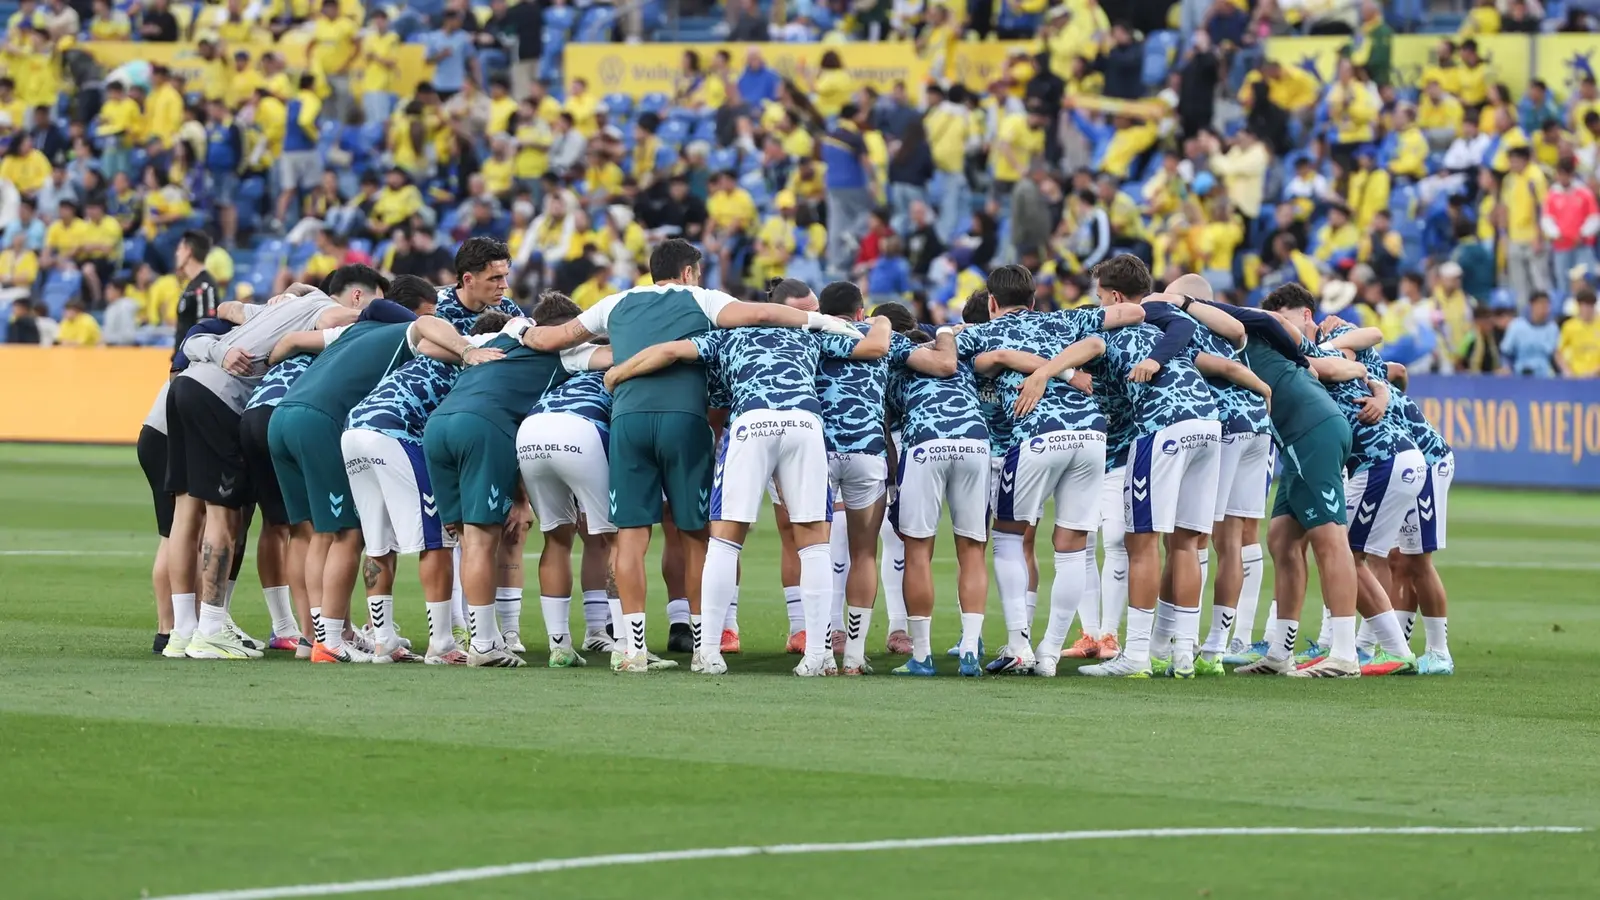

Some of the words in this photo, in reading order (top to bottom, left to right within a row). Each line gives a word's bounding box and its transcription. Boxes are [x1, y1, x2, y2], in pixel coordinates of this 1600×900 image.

[750, 421, 779, 430] COSTA
[780, 420, 798, 428] DEL
[799, 420, 814, 430] SOL
[1423, 397, 1519, 451] RISMO
[750, 427, 787, 438] MÁLAGA
[1048, 434, 1077, 444] COSTA
[1078, 433, 1095, 441] DEL
[1180, 433, 1205, 444] COSTA
[519, 444, 543, 454] COSTA
[544, 444, 562, 452] DEL
[563, 444, 583, 454] SOL
[928, 446, 957, 454] COSTA
[958, 445, 976, 454] DEL
[976, 446, 988, 455] SOL
[1049, 441, 1085, 452] MÁLAGA
[929, 453, 965, 463] MÁLAGA
